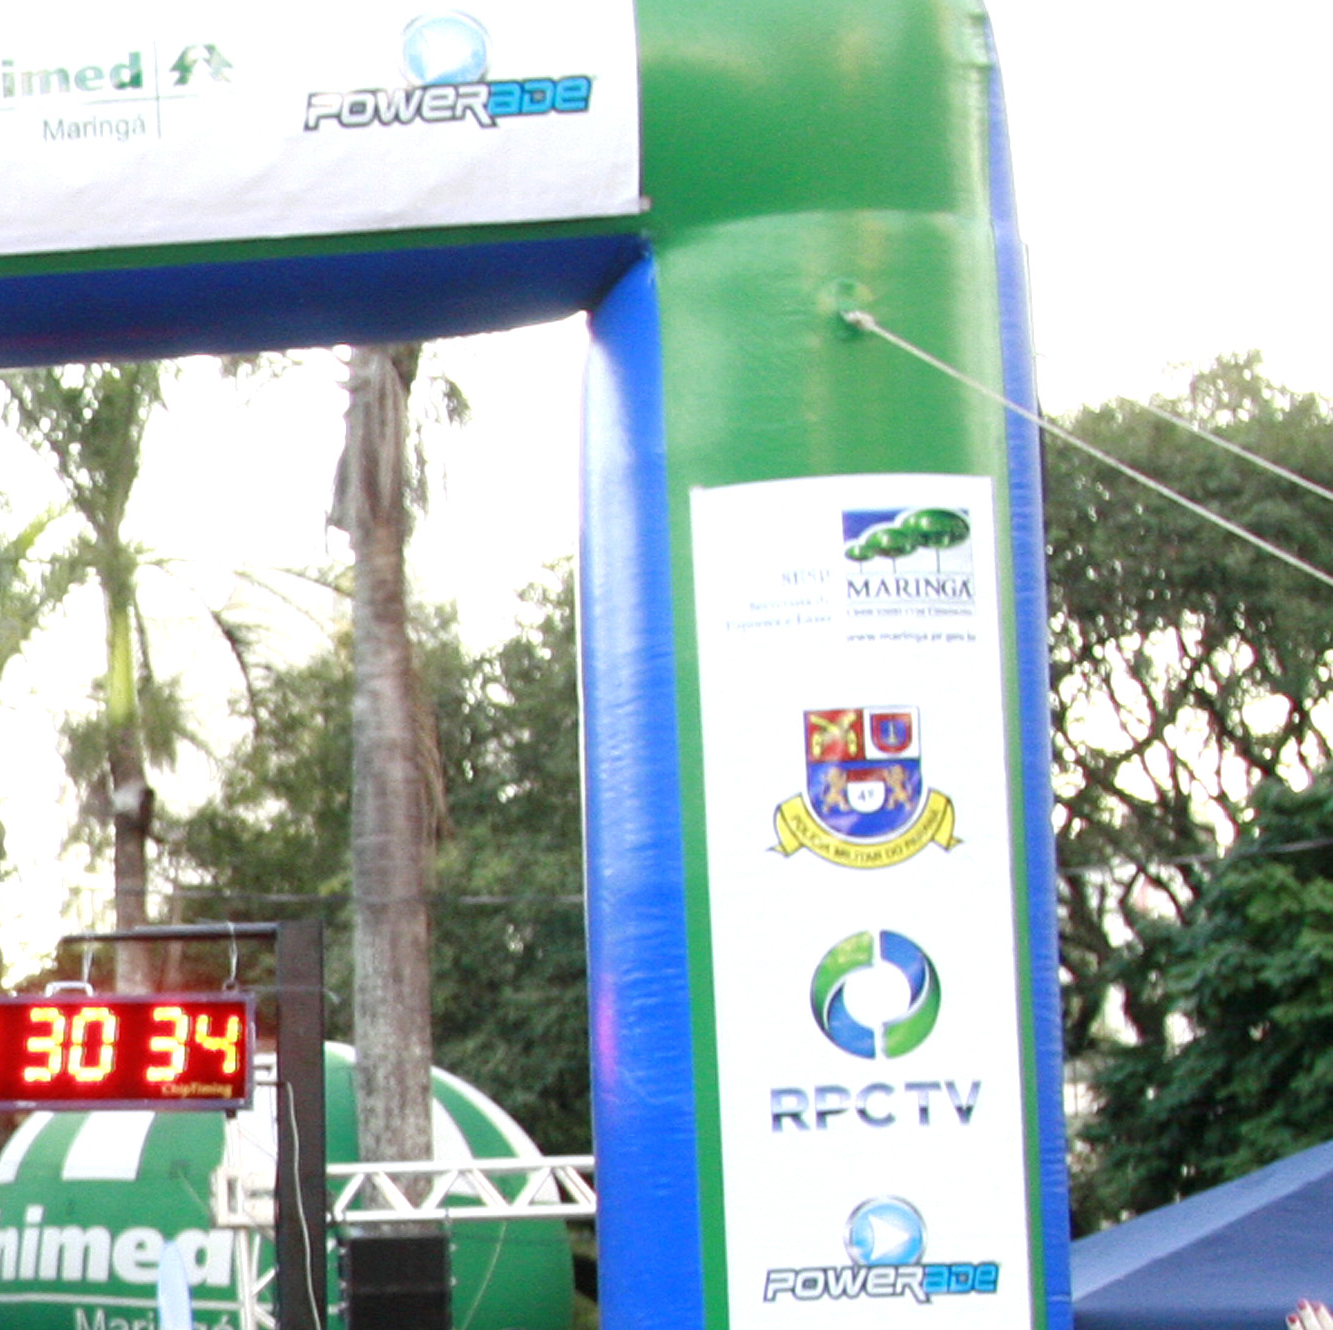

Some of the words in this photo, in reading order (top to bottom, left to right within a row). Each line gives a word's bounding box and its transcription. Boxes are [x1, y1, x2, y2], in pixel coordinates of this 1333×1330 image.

[41, 113, 146, 142] Maringá
[303, 76, 593, 131] POWERADE
[23, 1006, 117, 1082] 30
[145, 1006, 240, 1082] 34
[763, 1262, 1001, 1303] POWERADE
